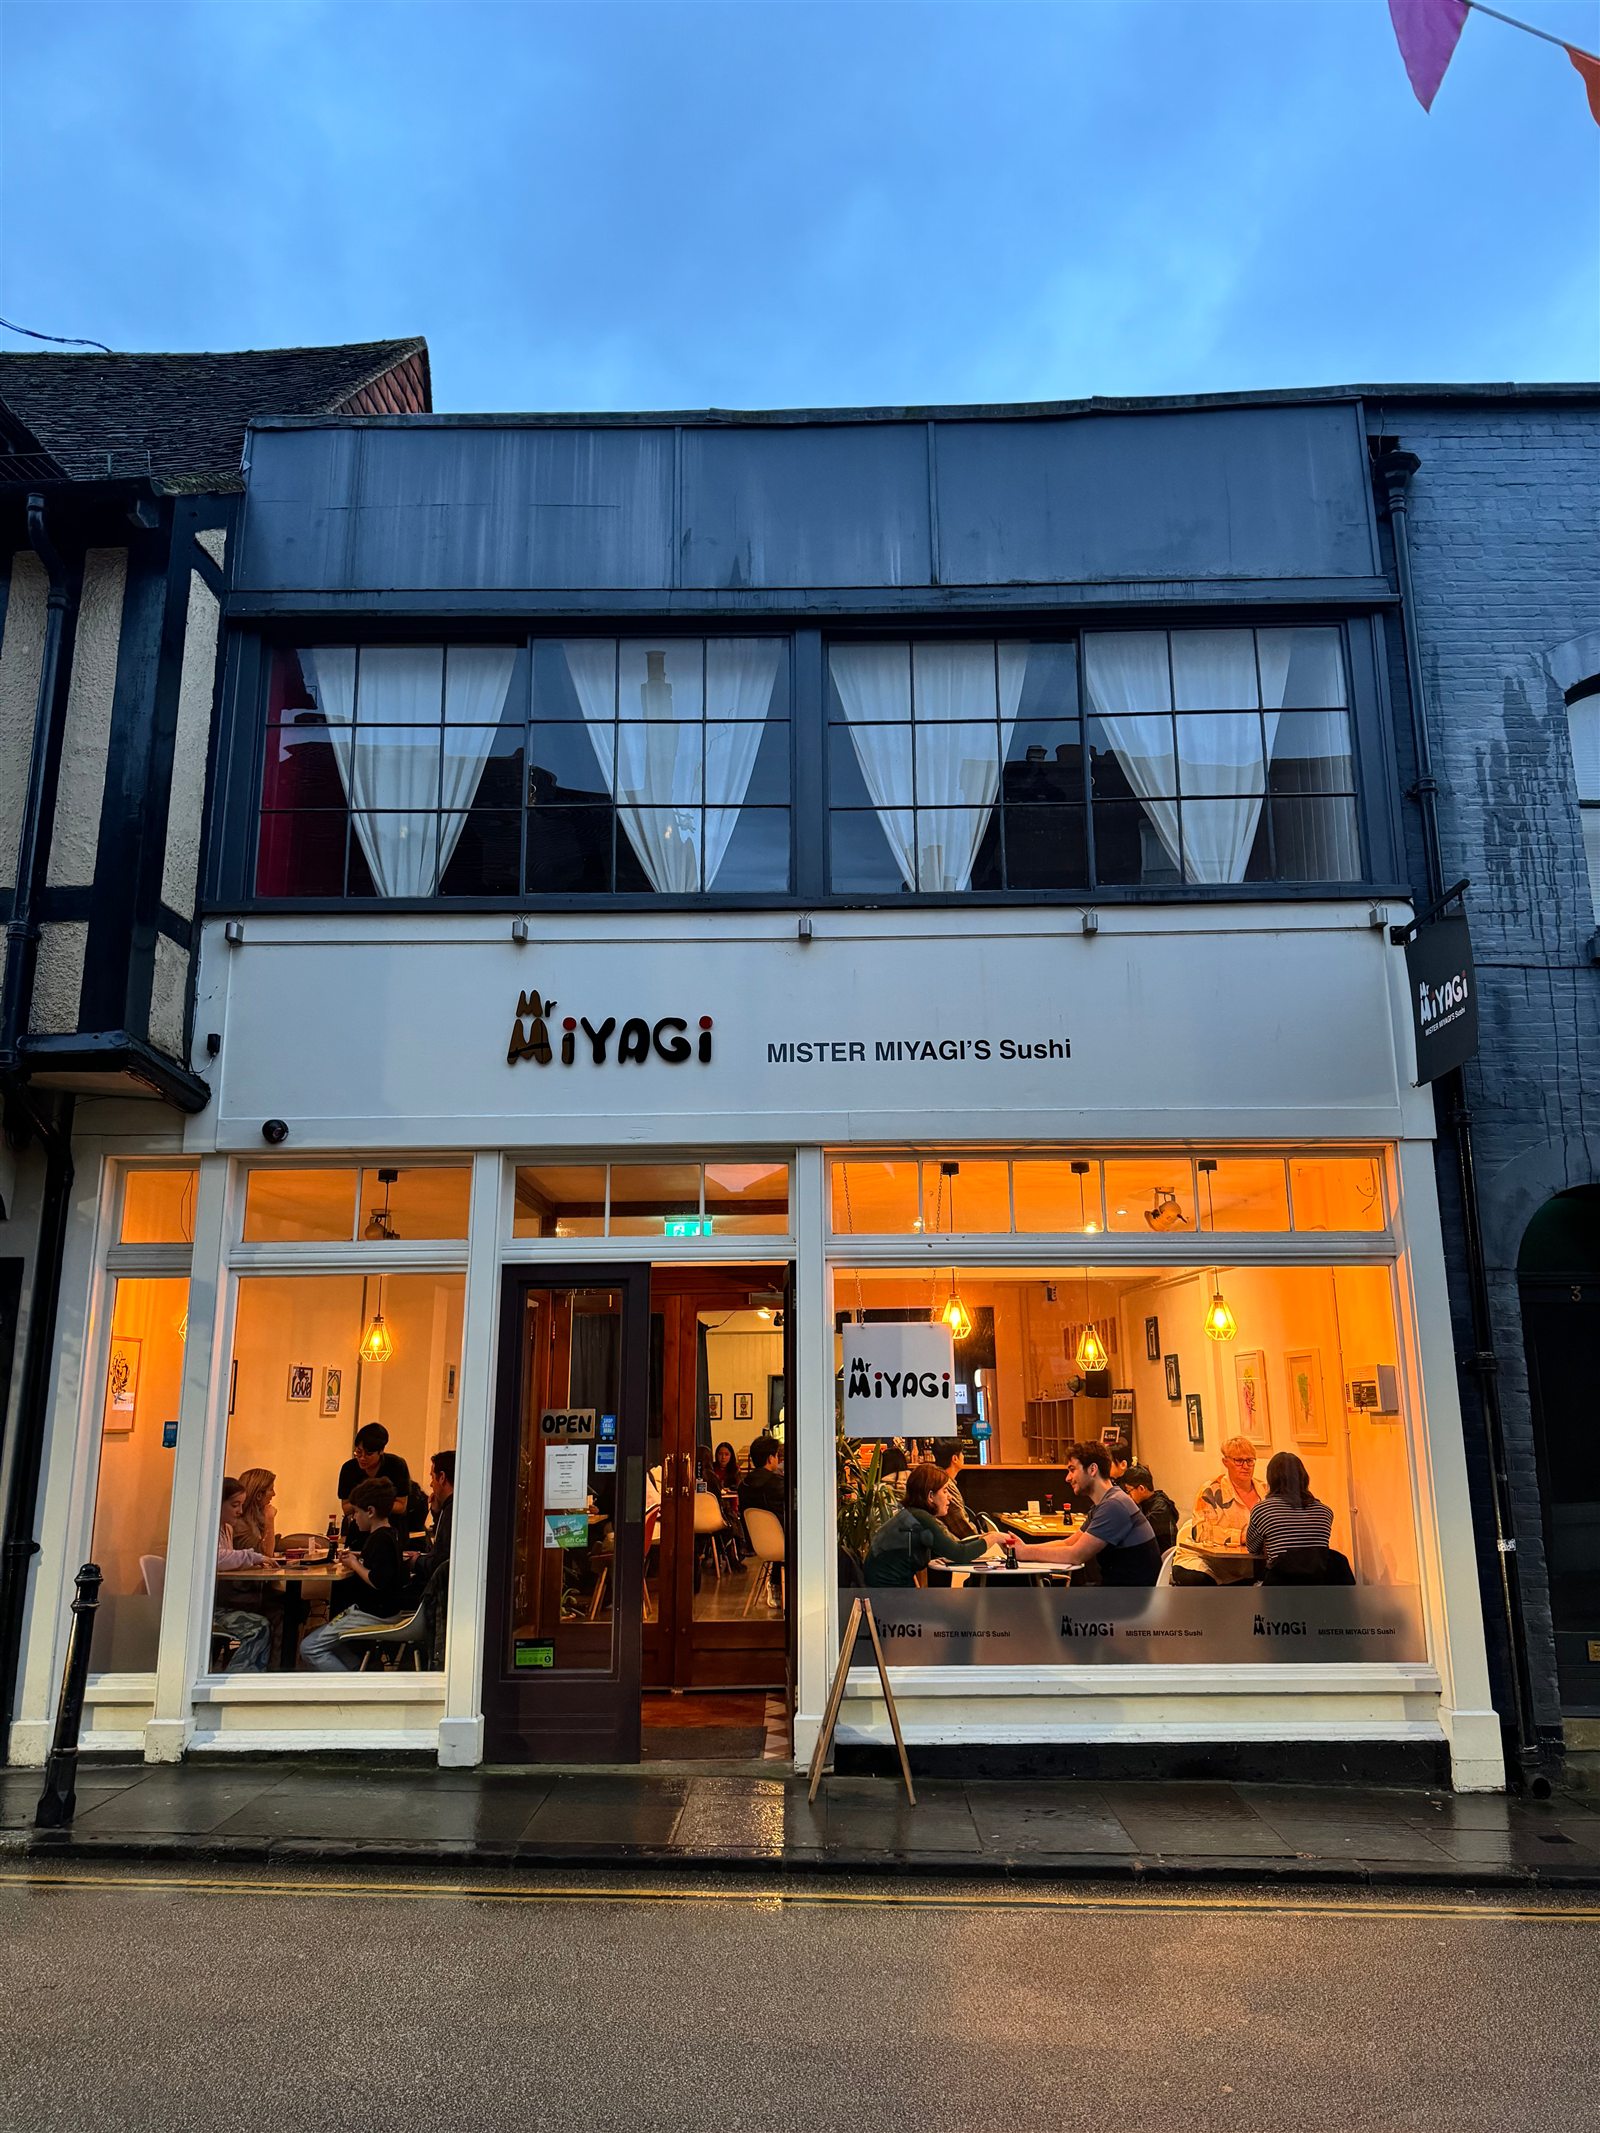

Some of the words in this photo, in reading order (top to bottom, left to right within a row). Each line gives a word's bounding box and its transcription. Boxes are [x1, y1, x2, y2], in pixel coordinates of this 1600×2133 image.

[516, 989, 557, 1017] Mr
[767, 1042, 866, 1063] MISTER
[875, 1039, 992, 1062] MIYAGI'S
[999, 1038, 1072, 1060] Sushi
[1570, 1285, 1581, 1302] 3
[851, 1357, 872, 1373] Mr
[542, 1414, 592, 1434] OPEN
[875, 1623, 922, 1638] iYAGi
[992, 1630, 1011, 1638] Sushi
[1125, 1629, 1151, 1637] MISTER
[1184, 1629, 1203, 1637] Sushi
[1377, 1627, 1396, 1635] Sushi
